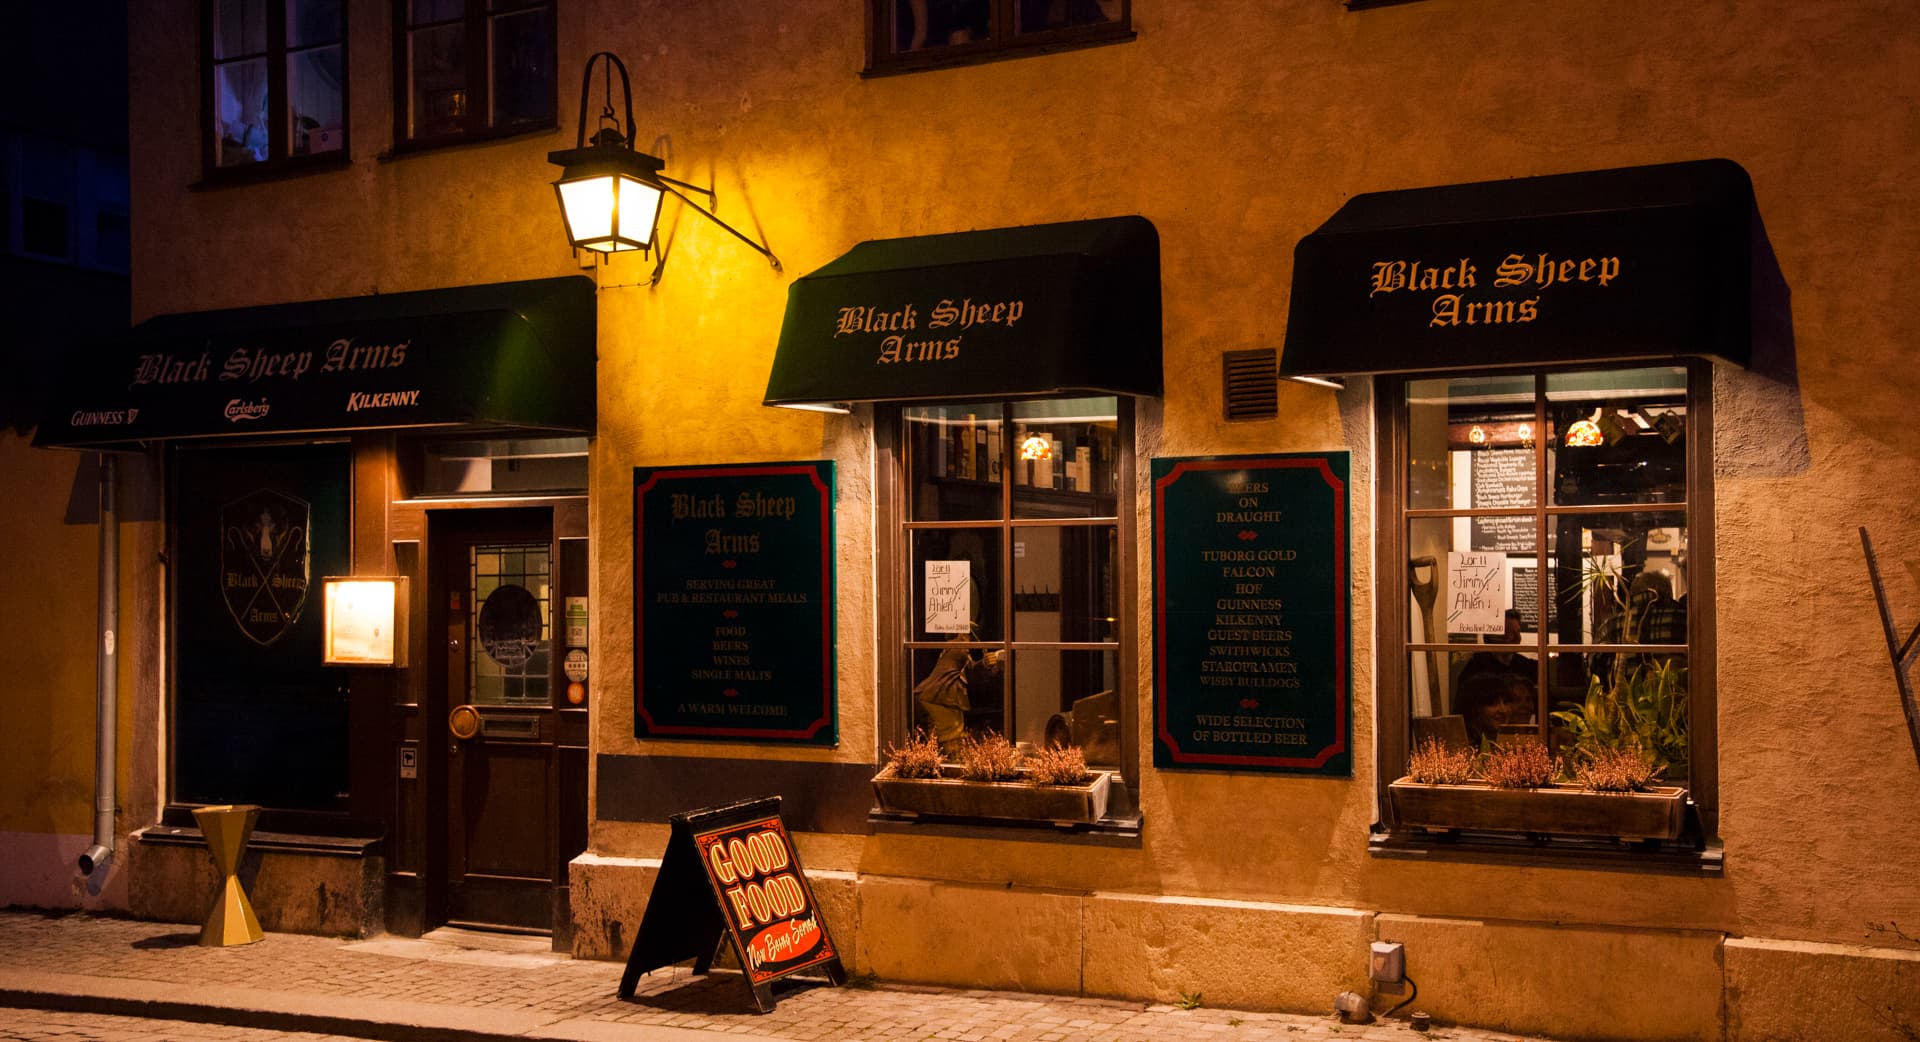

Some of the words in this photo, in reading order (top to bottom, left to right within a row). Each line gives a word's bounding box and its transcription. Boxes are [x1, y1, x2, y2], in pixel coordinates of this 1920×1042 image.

[1369, 257, 1477, 298] Black
[1494, 252, 1620, 290] Sheep
[1429, 293, 1540, 327] Arms
[833, 303, 918, 338] Black
[928, 298, 1024, 331] Sheep
[877, 335, 962, 365] Arms
[130, 348, 211, 388] Black
[219, 346, 312, 383] Sheep
[320, 338, 411, 373] Arms
[346, 390, 420, 412] KILKENNY
[224, 396, 270, 422] Carlsberg
[71, 410, 123, 426] GUINNESS
[671, 492, 727, 520] Black
[735, 490, 796, 520] Sheep
[1239, 497, 1258, 509] ON
[1215, 512, 1282, 523] DRAUGHT
[704, 528, 761, 556] Arms
[1201, 550, 1255, 561] TUBORG
[1258, 550, 1297, 561] GOLD
[1222, 566, 1276, 578] FALCON
[226, 573, 259, 589] Black
[272, 573, 306, 591] Sheep
[686, 579, 736, 590] SERVING
[737, 578, 777, 590] GREAT
[928, 576, 959, 602] Jimmy
[1235, 583, 1264, 595] HOF
[1452, 569, 1488, 596] Jimmy
[656, 592, 679, 604] PUB
[680, 593, 690, 604] &
[691, 592, 766, 604] RESTAURANT
[767, 592, 808, 604] MEALS
[1216, 599, 1282, 611] GUINNESS
[250, 608, 279, 624] Arms
[1215, 614, 1282, 626] KILKENNY
[714, 626, 747, 638] FOOD
[1208, 630, 1250, 641] GUEST
[1252, 630, 1293, 641] BEERS
[712, 640, 750, 652] BEERS
[712, 655, 751, 667] WINES
[1201, 660, 1297, 673] STAROPRAMEN
[691, 669, 732, 681] SINGLE
[734, 670, 773, 681] MALTS
[1200, 675, 1235, 687] WISBY
[677, 703, 687, 713] A
[688, 703, 726, 715] WARM
[727, 704, 788, 717] WELCOME
[1196, 715, 1231, 727] WIDE
[1233, 715, 1305, 729] SELECTION
[1192, 730, 1211, 742] OF
[1212, 731, 1273, 744] BOTTLED
[1274, 733, 1309, 745] BEER
[709, 830, 789, 885] GOOD
[727, 875, 805, 929] FOOD
[747, 944, 766, 970] Now
[765, 934, 792, 961] Being
